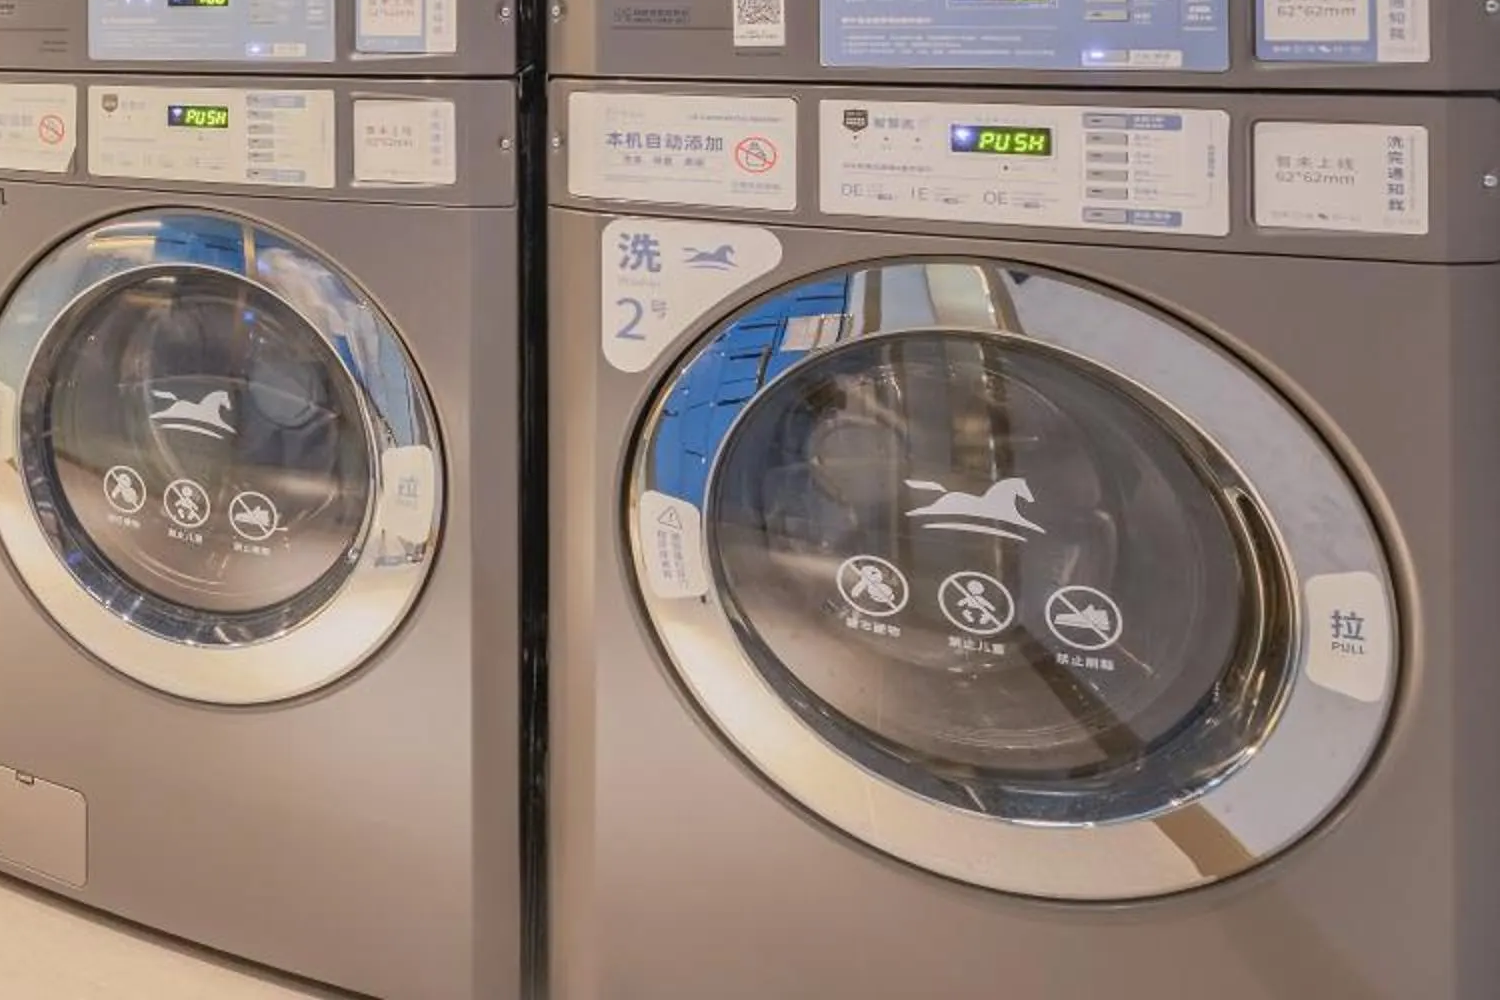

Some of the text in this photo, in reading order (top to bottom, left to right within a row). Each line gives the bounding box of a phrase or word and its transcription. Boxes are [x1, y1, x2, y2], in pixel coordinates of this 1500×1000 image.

[184, 109, 228, 126] PUSH
[605, 131, 724, 152] 本机自动添加
[978, 130, 1047, 153] PUSH
[618, 232, 663, 274] 洗
[1331, 609, 1365, 642] 拉
